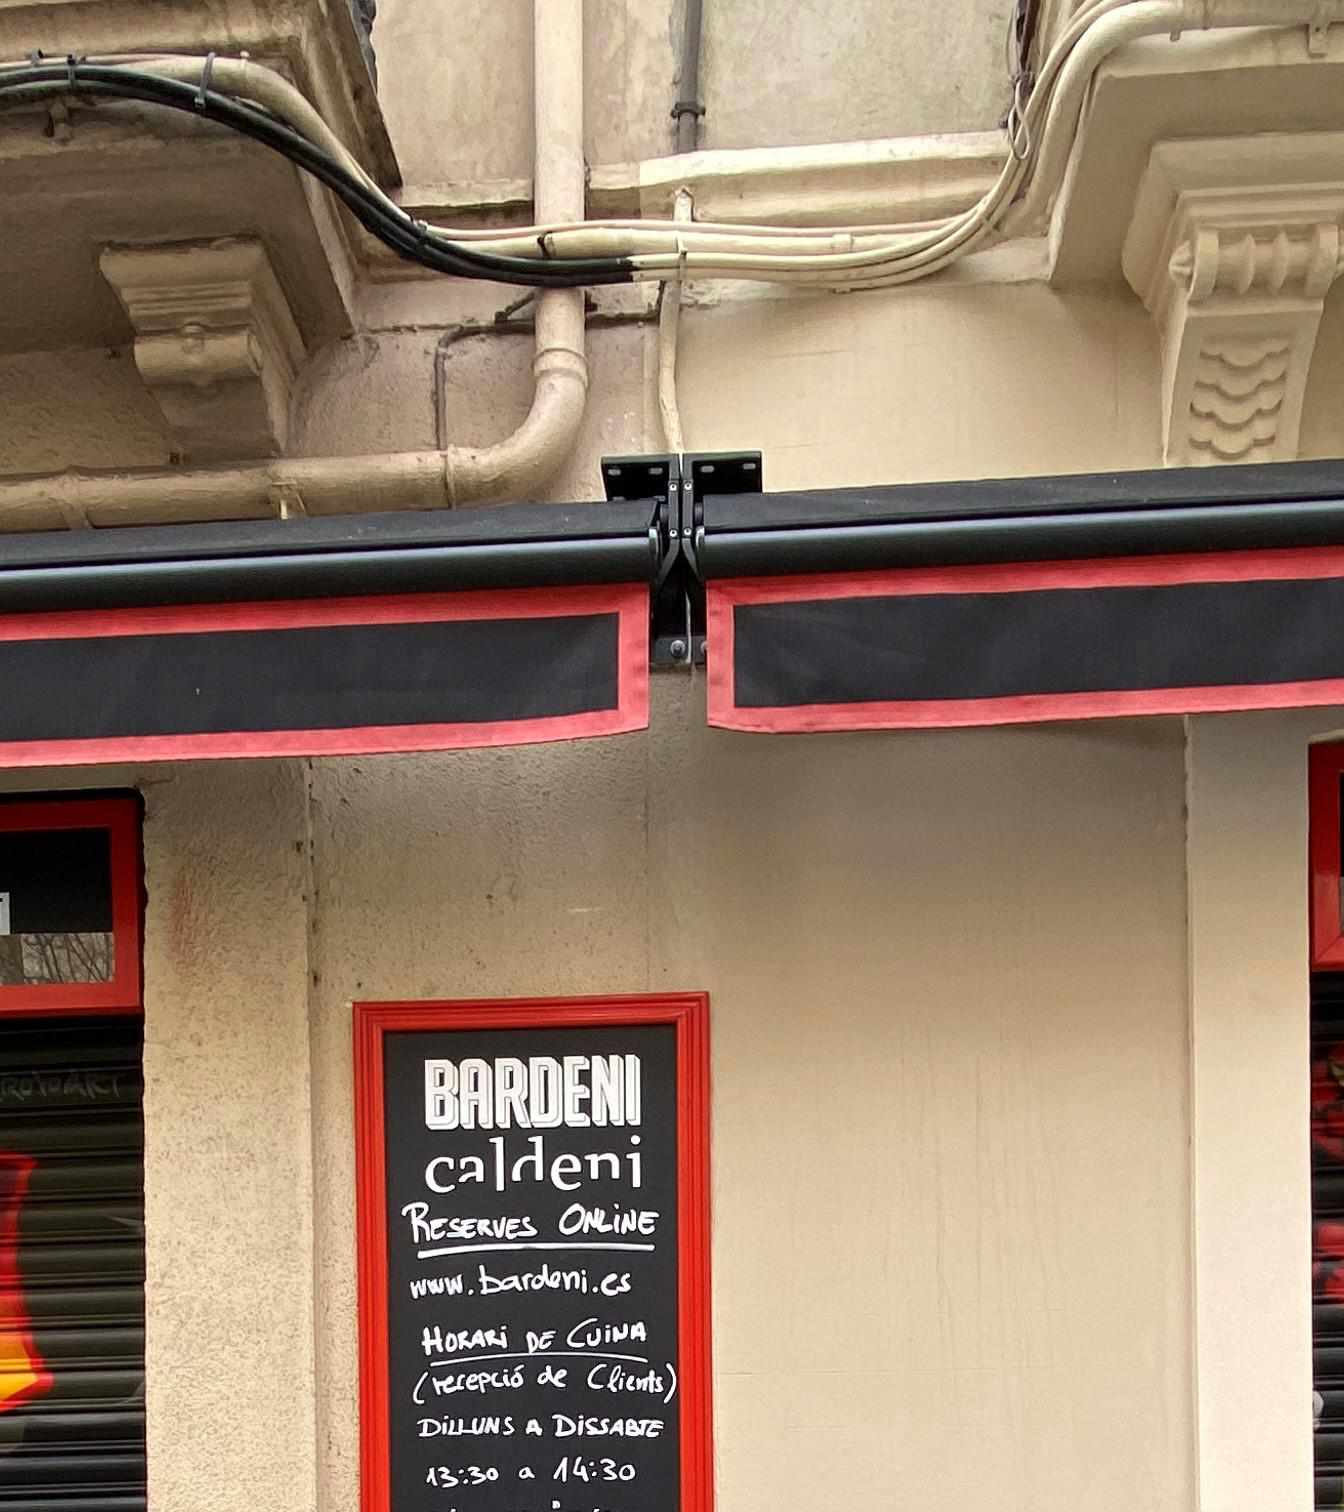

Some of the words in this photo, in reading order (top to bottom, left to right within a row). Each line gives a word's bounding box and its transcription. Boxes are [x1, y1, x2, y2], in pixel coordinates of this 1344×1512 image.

[424, 1054, 641, 1131] BARDENI
[424, 1134, 641, 1193] caldeni
[402, 1201, 537, 1243] RESERVES
[411, 1264, 631, 1299] www.bardeni.es
[526, 1330, 556, 1354] DE
[537, 1366, 568, 1386] de
[426, 1466, 499, 1488] 13:30
[518, 1467, 535, 1480] a
[553, 1456, 636, 1483] 14:30
